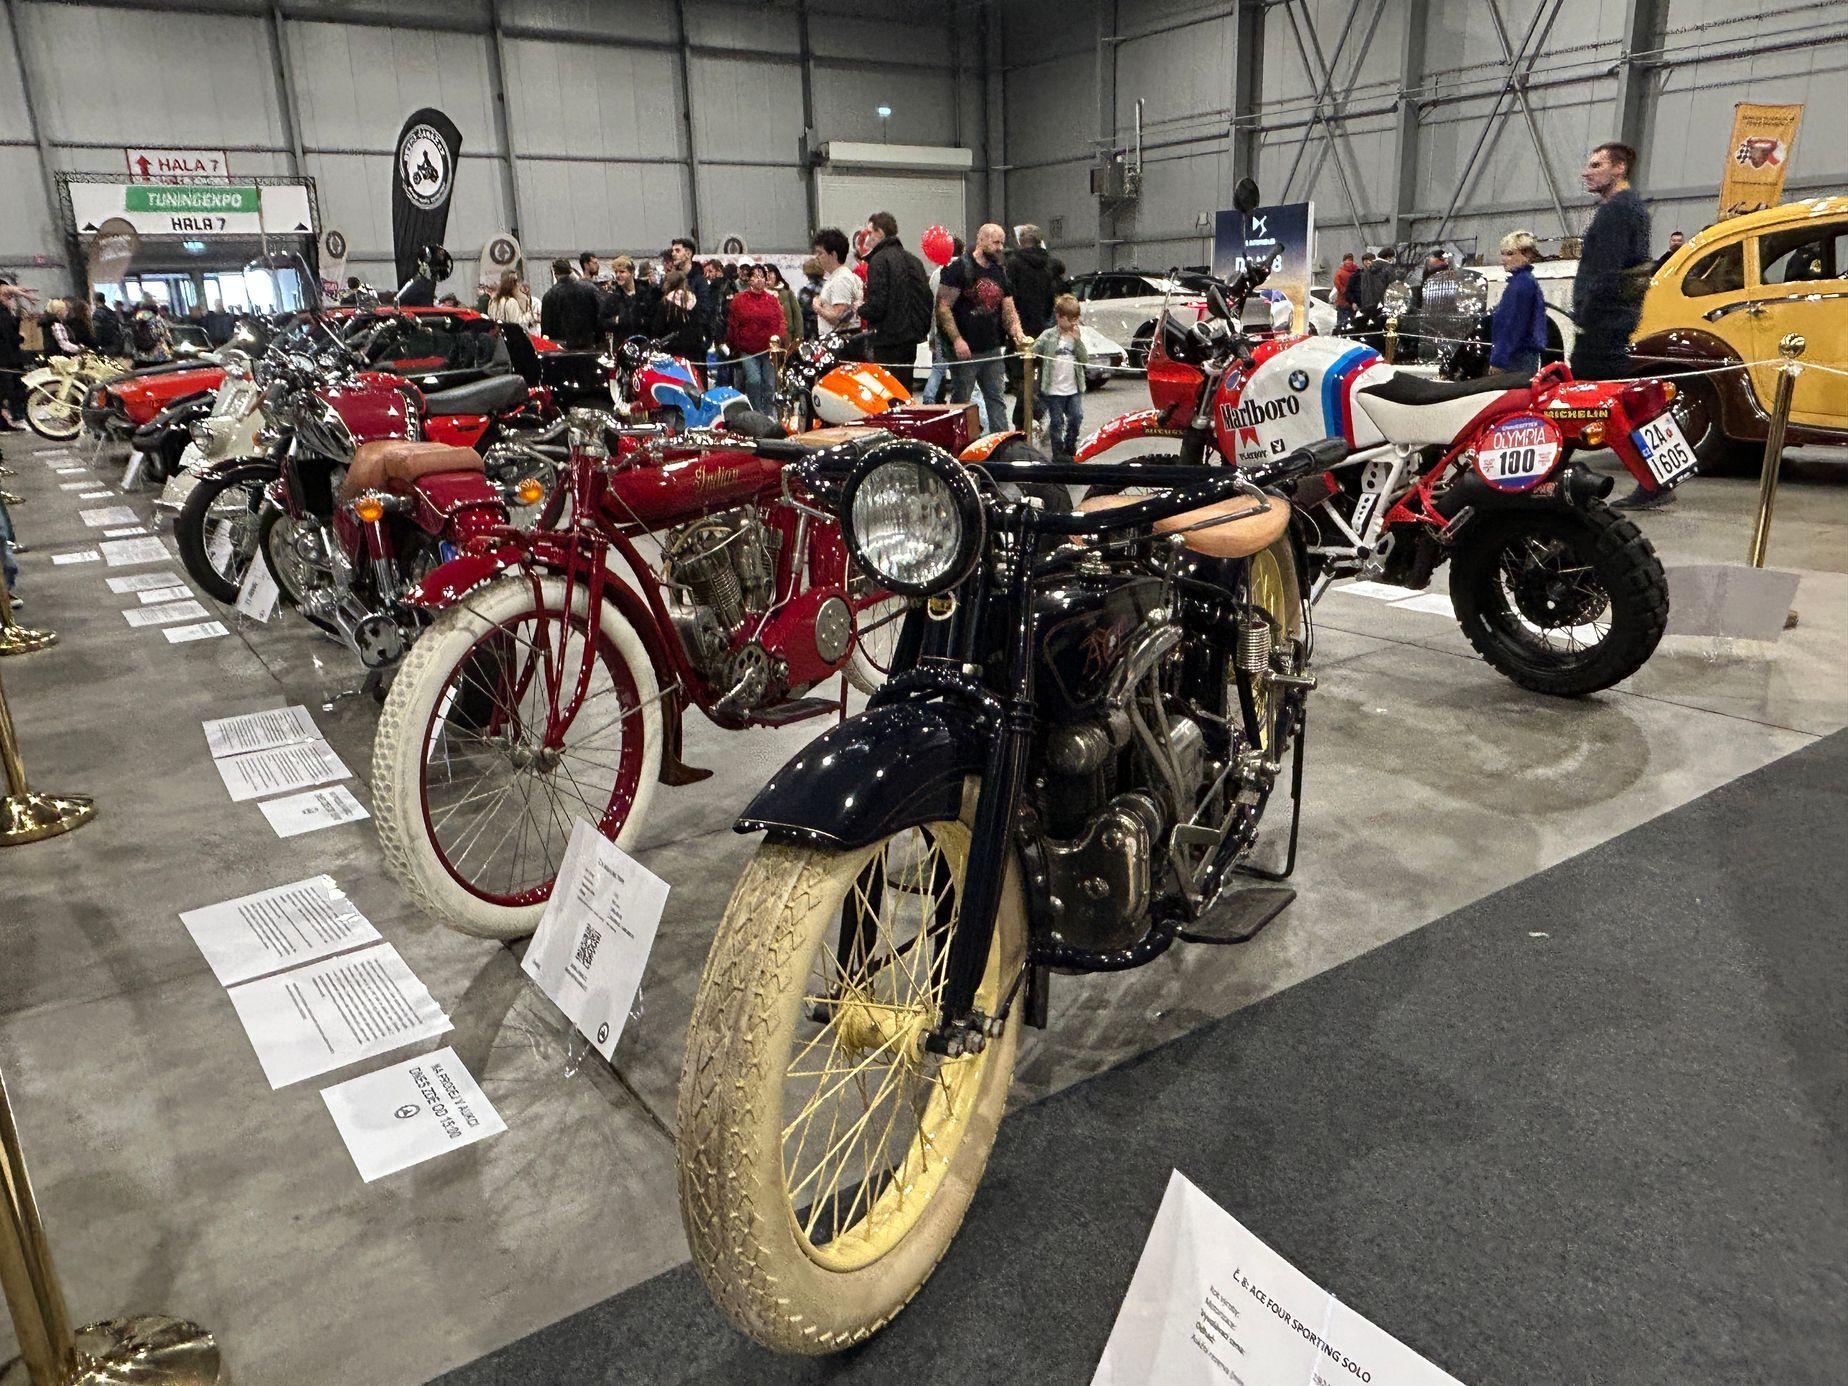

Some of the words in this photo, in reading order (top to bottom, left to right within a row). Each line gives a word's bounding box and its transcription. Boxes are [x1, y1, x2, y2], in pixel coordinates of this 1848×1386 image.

[158, 158, 206, 172] HALA
[210, 159, 219, 172] 7
[171, 217, 213, 231] HALA
[217, 217, 226, 231] 7
[1220, 394, 1300, 431] Marlboro
[1493, 427, 1546, 450] OLYMPIA
[1644, 424, 1668, 450] 2A
[1499, 448, 1536, 476] 100
[1650, 442, 1689, 479] 1605
[694, 465, 739, 490] Indian
[1249, 1285, 1267, 1305] ACE
[1266, 1298, 1292, 1325] FOUR
[1291, 1318, 1341, 1362] SPORTING
[1341, 1357, 1371, 1383] SOLO
